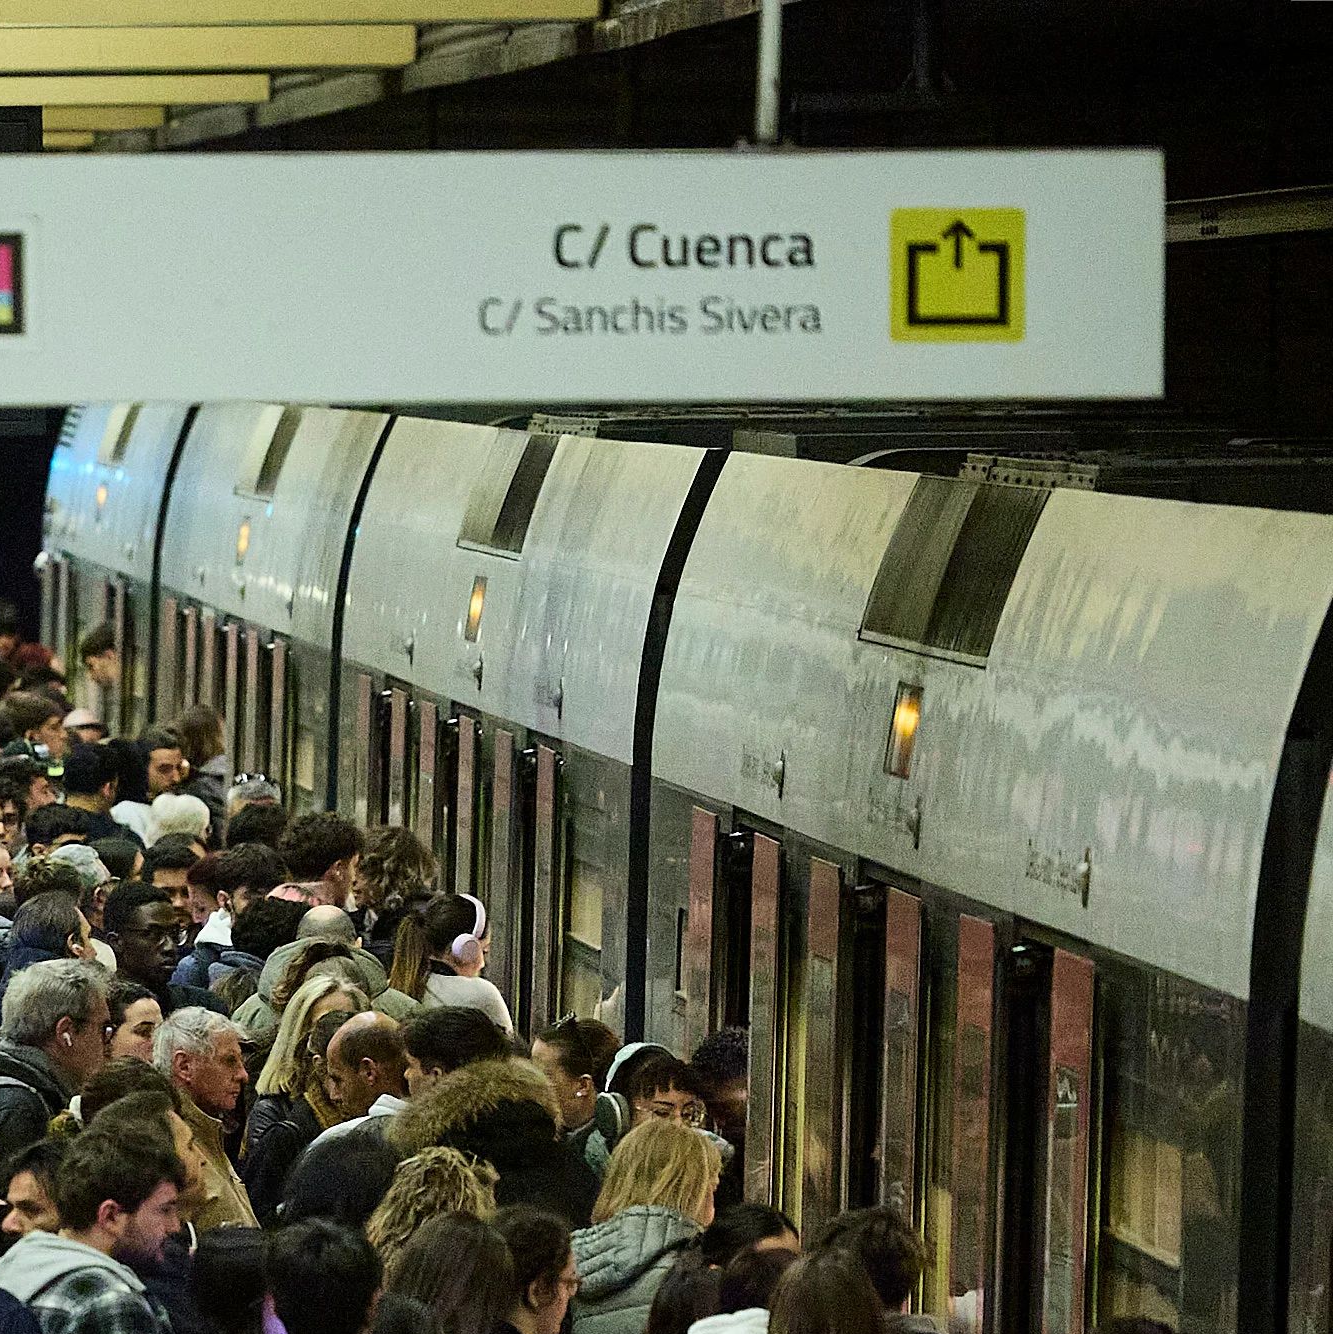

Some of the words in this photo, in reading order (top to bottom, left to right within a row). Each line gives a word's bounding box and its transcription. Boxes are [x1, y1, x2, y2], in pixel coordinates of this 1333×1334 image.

[552, 222, 610, 269] C/
[629, 222, 815, 268] Cuenca
[478, 297, 523, 336] C/
[534, 296, 688, 335] Sanchis
[699, 296, 823, 335] Sivera
